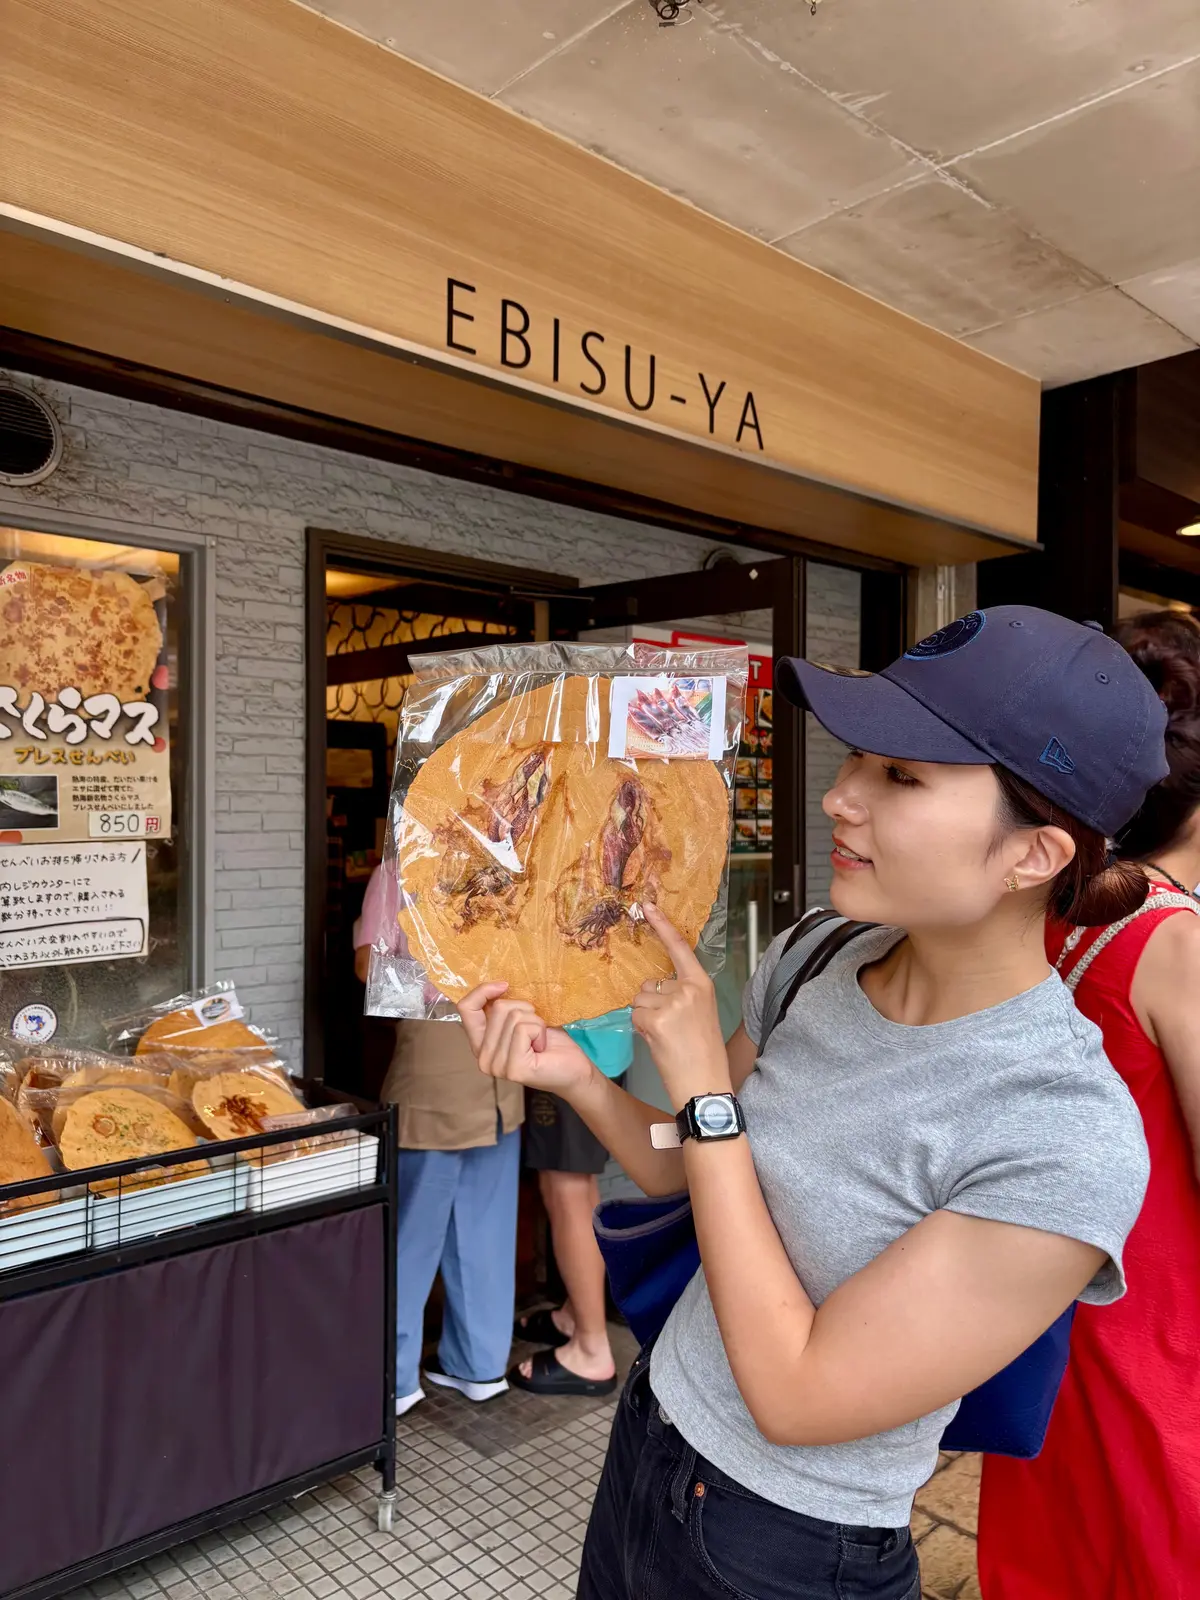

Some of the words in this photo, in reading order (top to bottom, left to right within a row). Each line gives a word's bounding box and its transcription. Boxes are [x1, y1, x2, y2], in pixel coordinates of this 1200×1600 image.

[446, 277, 764, 451] EBISU-YA
[14, 746, 137, 765] プレスせんべい
[99, 813, 140, 833] 850
[145, 817, 159, 832] 円
